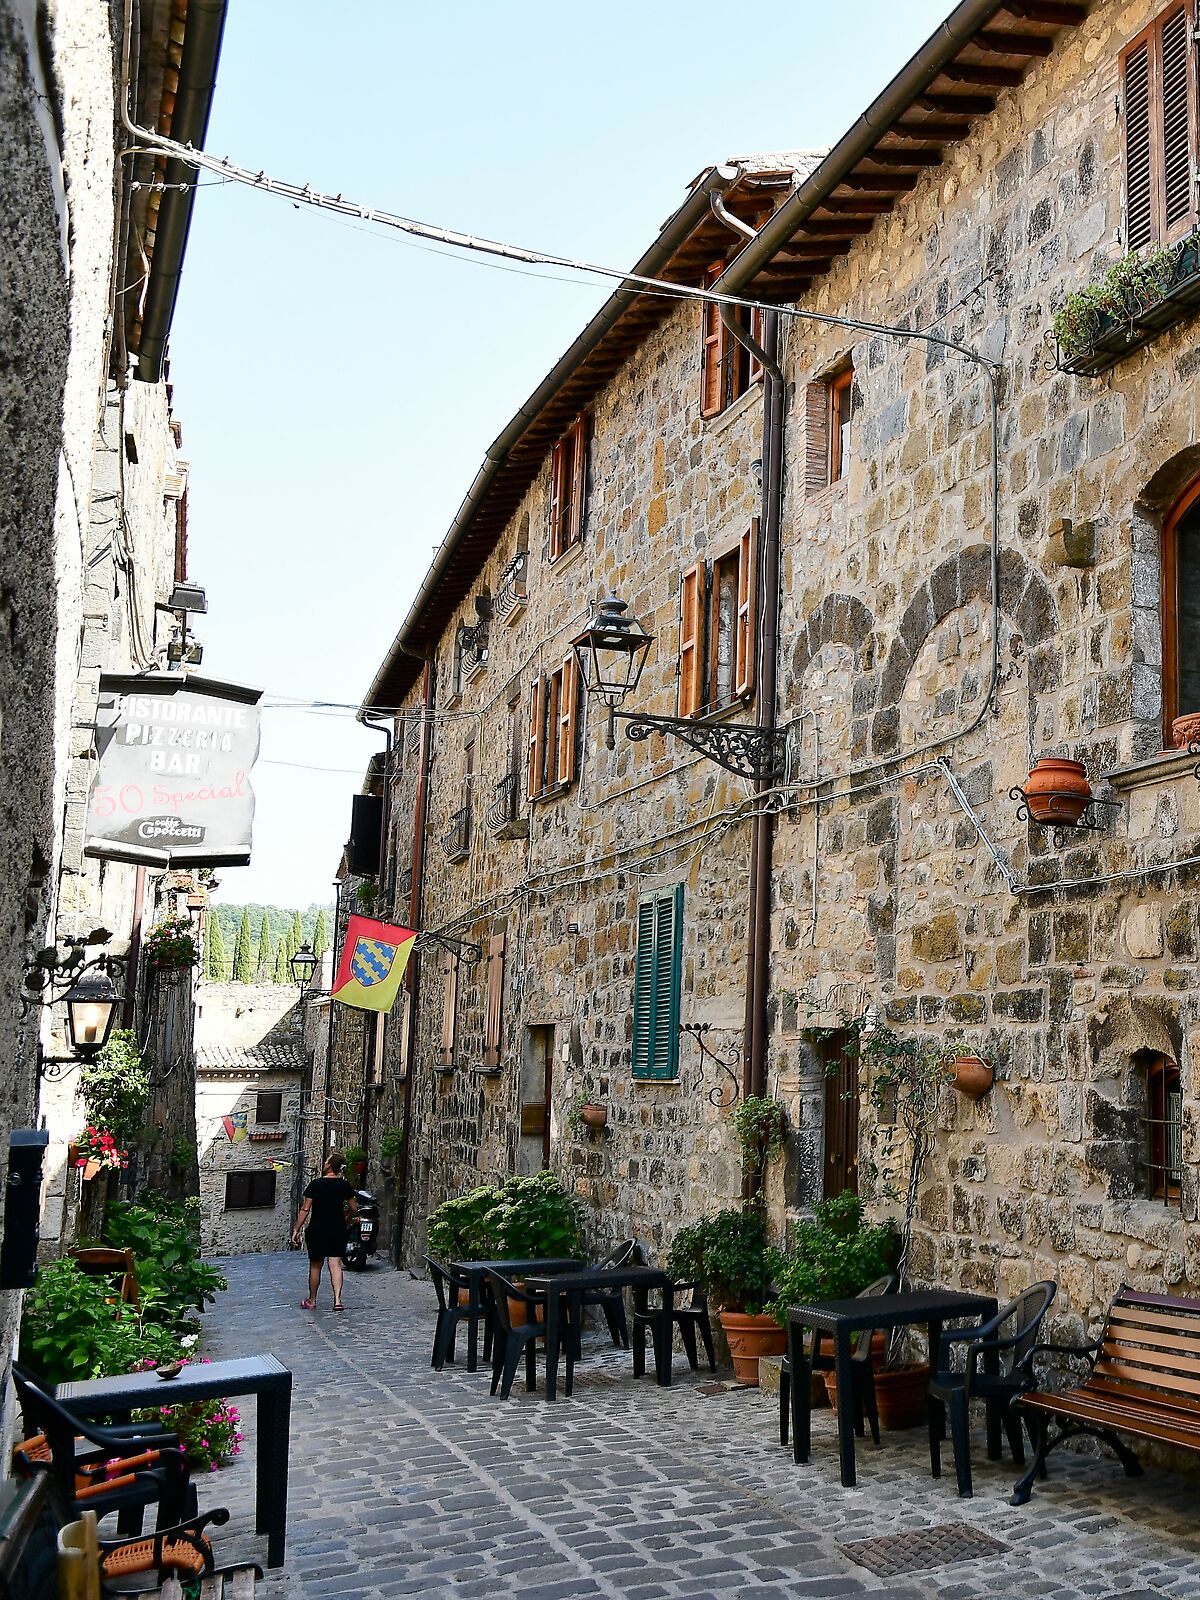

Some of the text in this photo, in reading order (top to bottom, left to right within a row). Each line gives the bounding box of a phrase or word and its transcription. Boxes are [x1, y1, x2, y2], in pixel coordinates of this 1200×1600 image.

[114, 696, 248, 728] RISTORANTE
[126, 723, 232, 752] PIZZERIA
[151, 750, 201, 774] BAR
[95, 770, 246, 816] 50 Special
